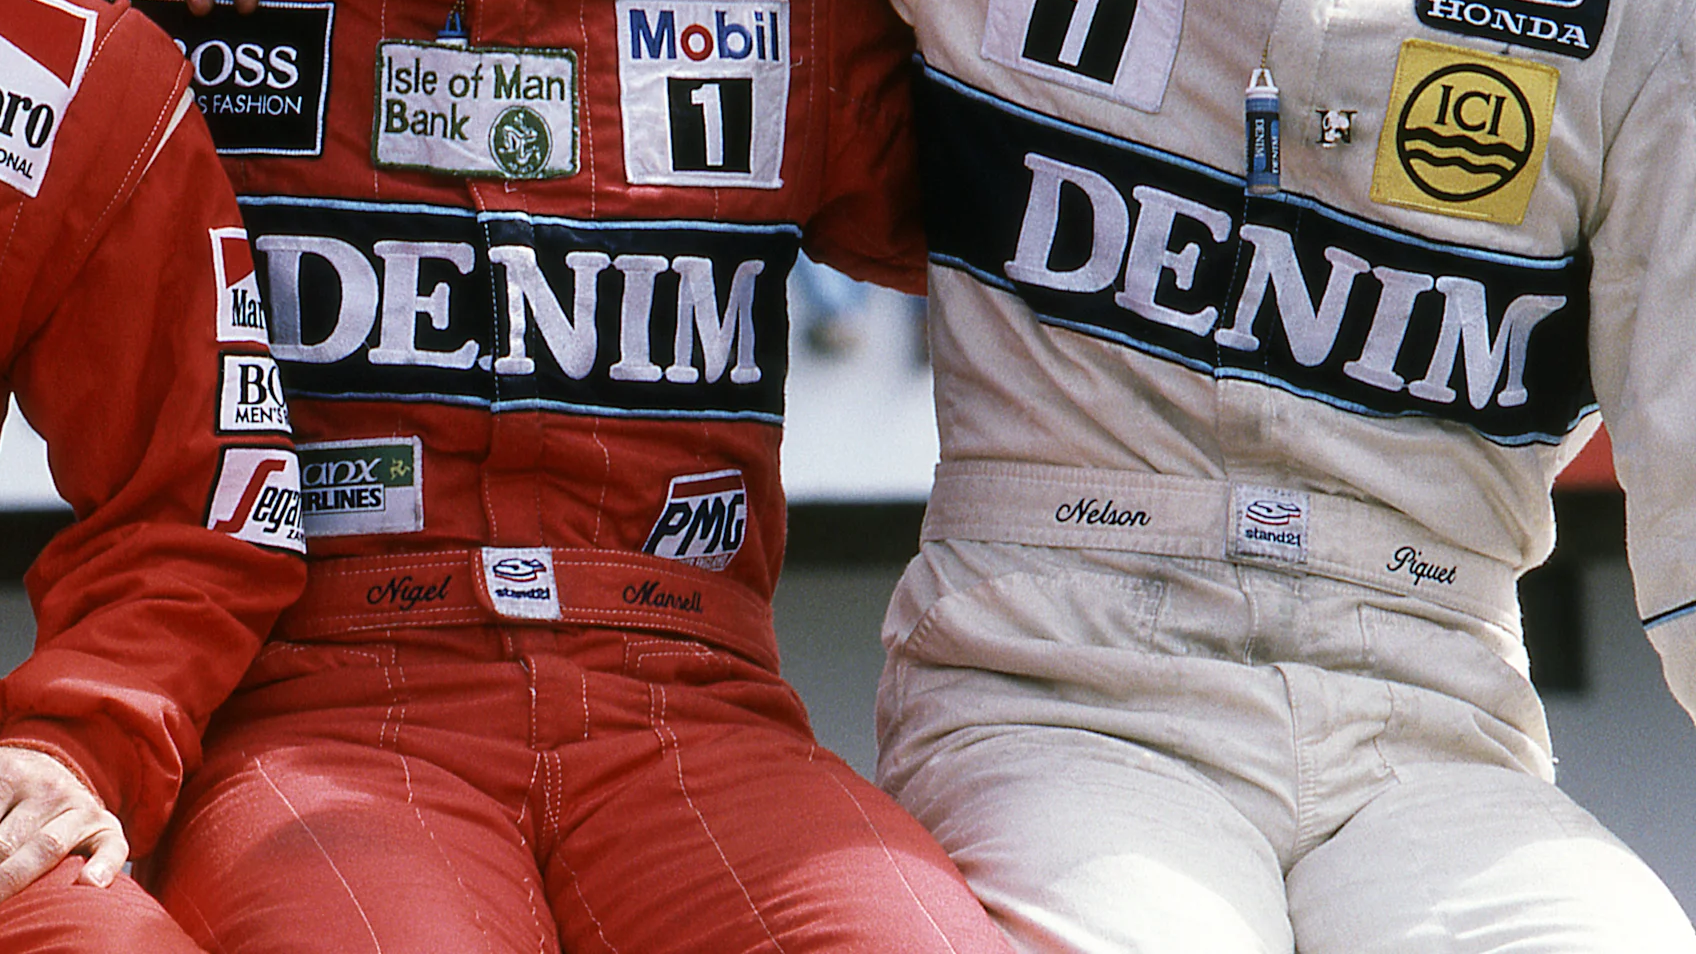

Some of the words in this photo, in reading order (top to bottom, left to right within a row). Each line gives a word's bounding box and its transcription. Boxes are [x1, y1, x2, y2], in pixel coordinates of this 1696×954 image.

[629, 9, 780, 62] Mobil
[173, 37, 299, 89] OSS
[387, 56, 437, 95] Isle
[448, 63, 483, 98] of
[494, 63, 564, 100] Man
[213, 94, 302, 115] FASHION
[385, 99, 470, 140] Bank
[690, 83, 723, 166] 1
[1435, 84, 1506, 136] ICI
[1255, 118, 1265, 157] DENIM
[1005, 153, 1566, 409] DENIM
[255, 234, 764, 384] DENIM
[304, 458, 382, 484] anx
[304, 488, 381, 511] RLINES
[1055, 499, 1151, 526] Nelson
[644, 494, 744, 556] PMG
[1387, 547, 1457, 586] Piquet
[367, 575, 452, 611] Nigel
